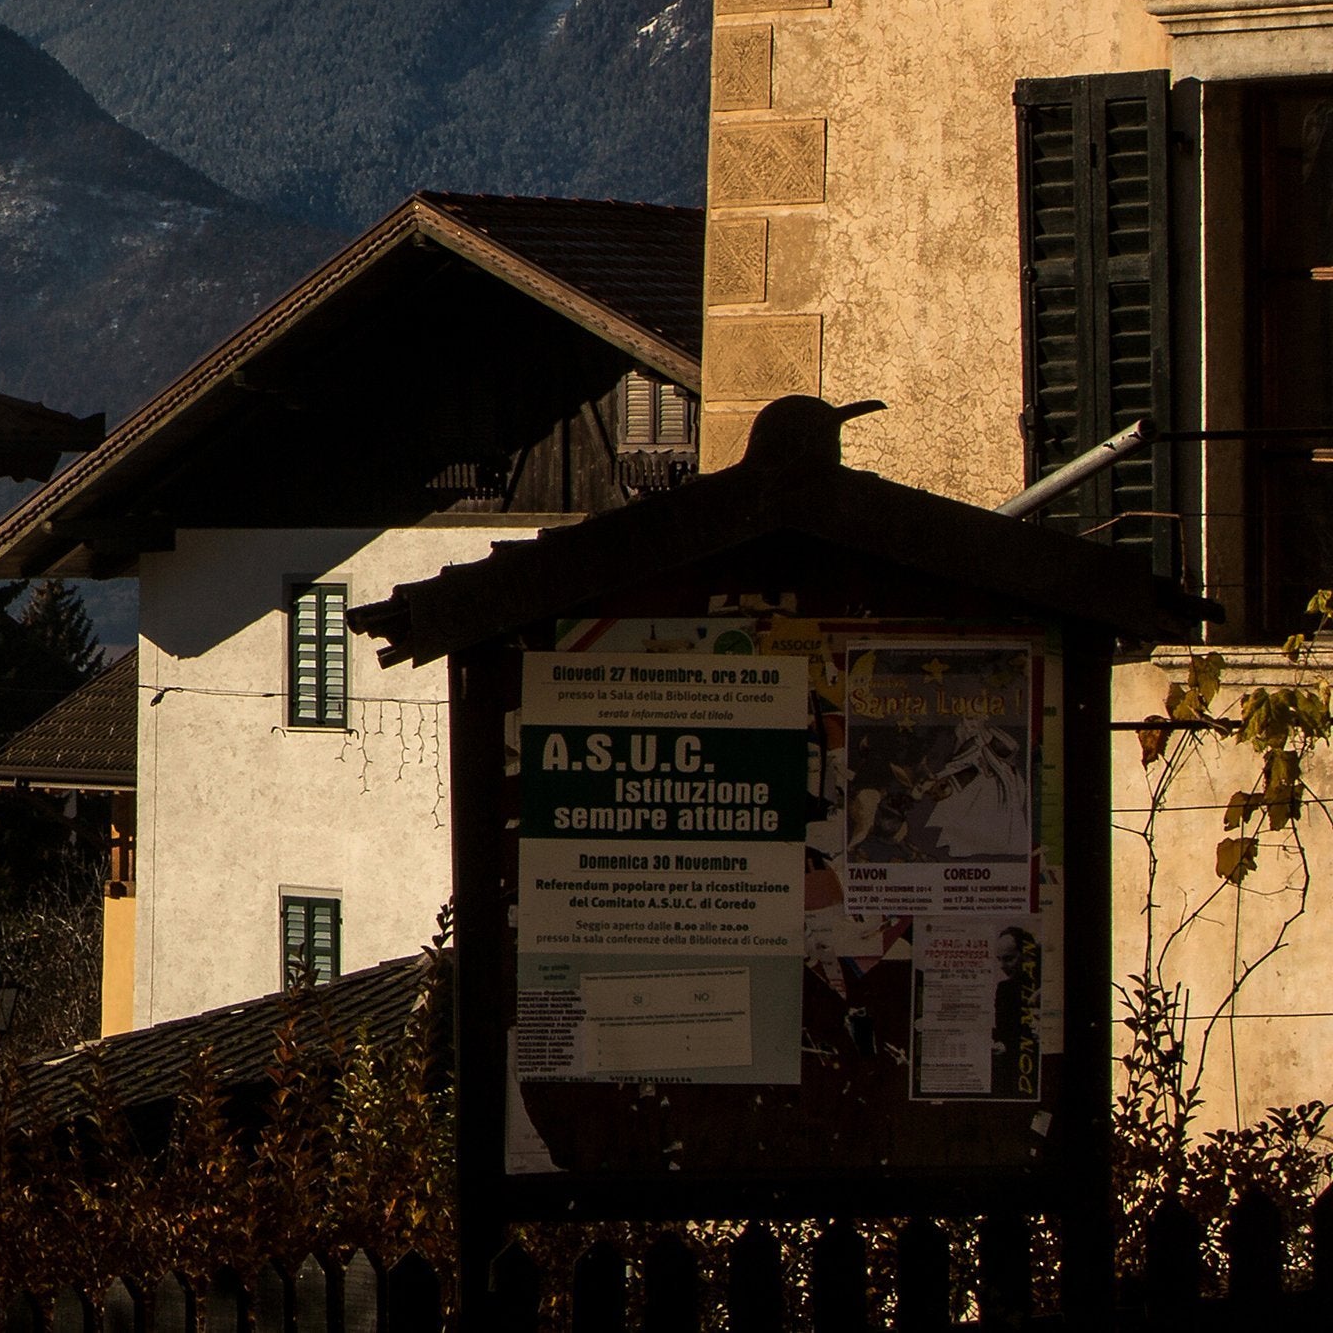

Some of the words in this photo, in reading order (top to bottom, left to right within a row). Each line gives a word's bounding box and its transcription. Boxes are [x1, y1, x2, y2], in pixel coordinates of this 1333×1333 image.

[553, 665, 605, 681] Giovedì
[610, 667, 625, 682] 27
[630, 668, 707, 685] Novembre,
[712, 670, 736, 683] ore
[740, 669, 779, 684] 20.00
[558, 691, 595, 702] presso
[597, 690, 607, 700] la
[610, 690, 633, 701] Sala
[637, 690, 663, 701] della
[666, 691, 719, 702] Biblioteca
[722, 691, 733, 702] di
[736, 691, 774, 703] Coredo
[850, 688, 927, 716] Santa
[934, 689, 1006, 716] Lucia
[598, 709, 629, 718] serata
[631, 708, 688, 720] informativa
[708, 709, 733, 720] titolo
[542, 732, 716, 773] A.S.U.C.
[615, 777, 770, 804] Istituzione
[553, 807, 668, 831] sempre
[677, 806, 780, 832] attuale
[579, 854, 648, 870] Domenica
[653, 856, 670, 870] 30
[675, 856, 747, 871] Novembre
[848, 868, 887, 880] TAVON
[943, 868, 991, 880] COREDO
[535, 879, 609, 891] Referendum
[613, 880, 666, 894] popolare
[669, 883, 688, 894] per
[691, 881, 703, 892] la
[706, 881, 790, 893] ricostituzione
[569, 896, 588, 908] del
[591, 897, 645, 909] Comitato
[648, 898, 696, 909] A.S.U.C.
[700, 898, 711, 909] di
[715, 898, 756, 910] Coredo
[576, 921, 609, 932] Seggio
[613, 922, 644, 932] aperto
[647, 921, 672, 931] dalle
[674, 922, 697, 931] 8.00
[700, 921, 718, 931] alle
[720, 923, 749, 932] 20.00
[536, 934, 569, 945] presso
[571, 933, 581, 943] la
[583, 933, 603, 943] sala
[606, 934, 659, 944] conferenze
[662, 934, 687, 944] della
[689, 935, 738, 945] Biblioteca
[741, 935, 750, 945] di
[753, 936, 788, 946] Coredo
[694, 992, 709, 1002] NO
[1017, 1035, 1035, 1094] DON
